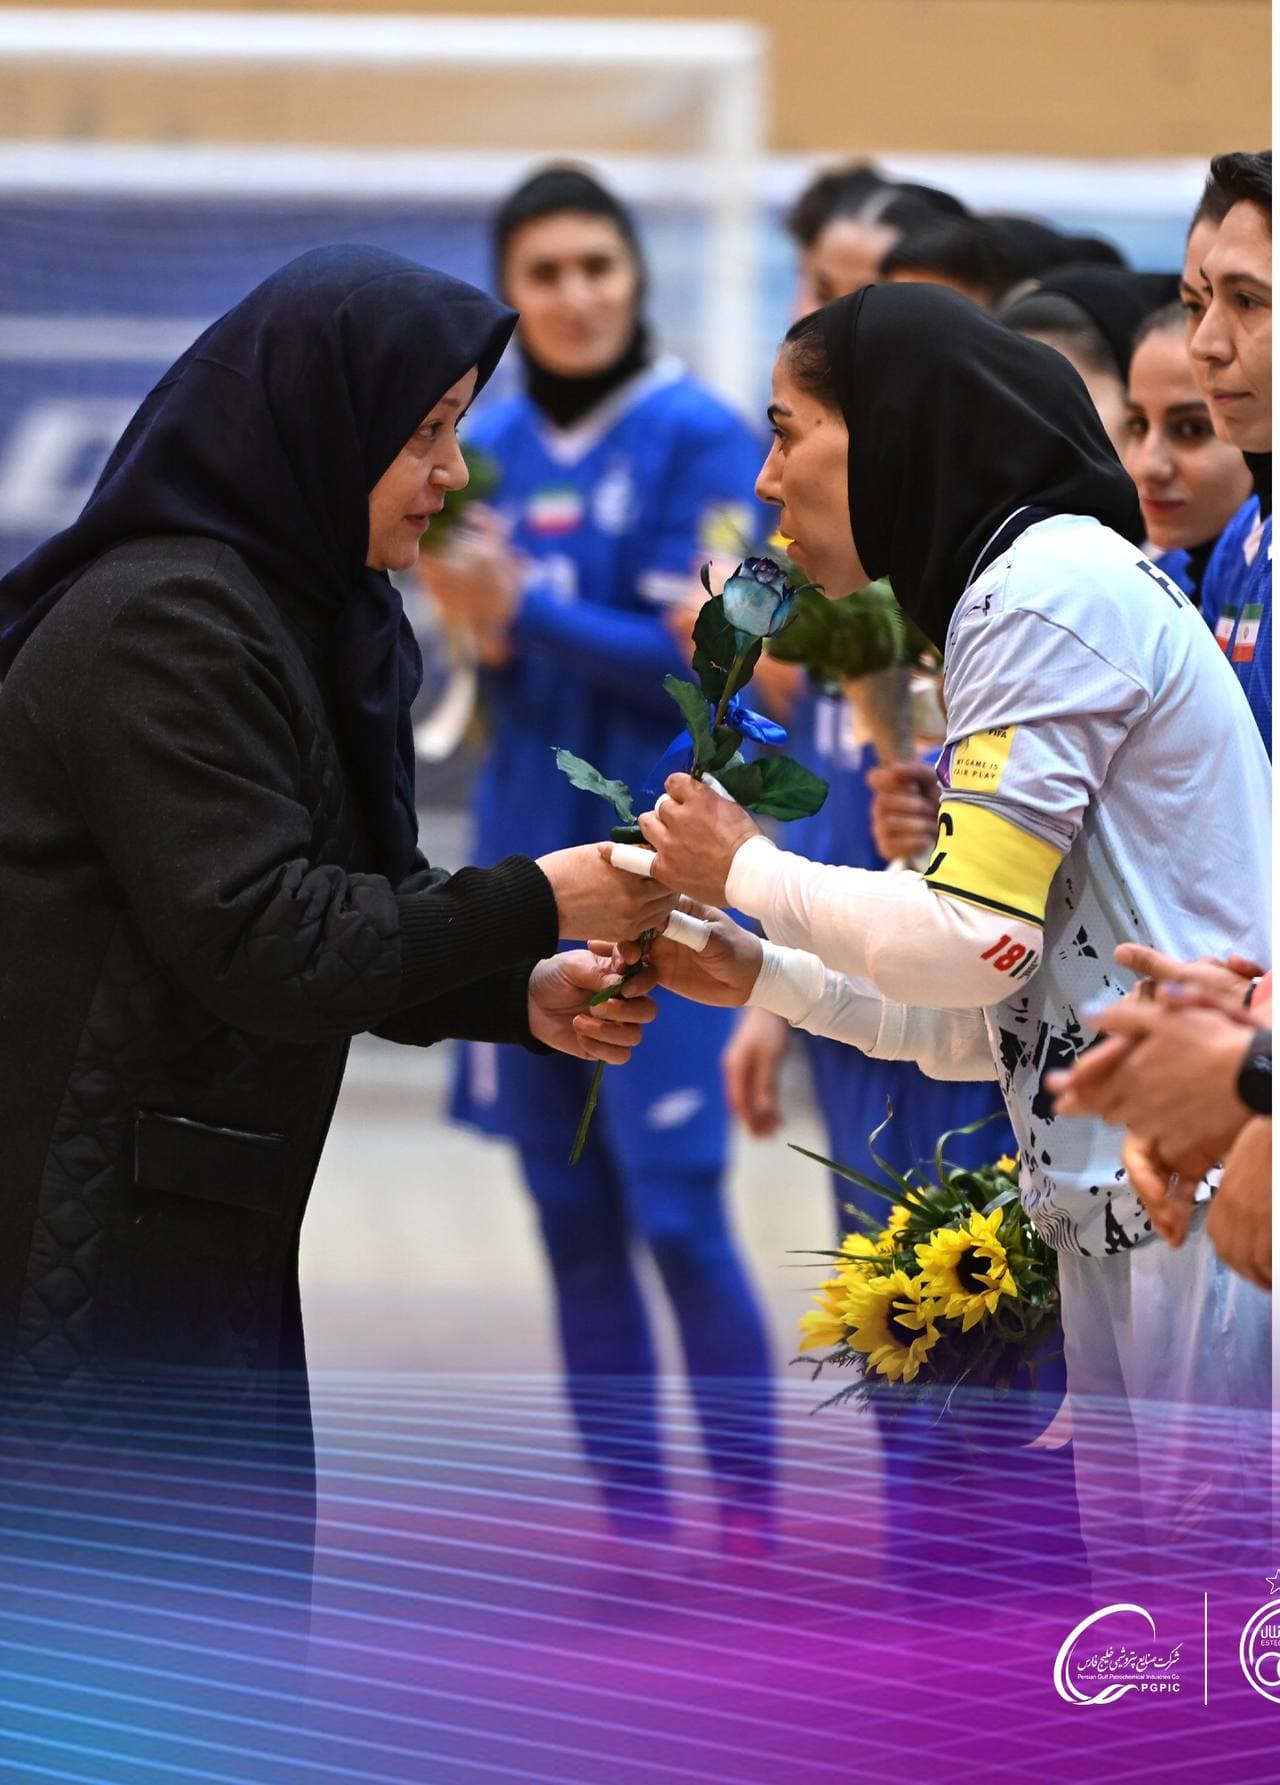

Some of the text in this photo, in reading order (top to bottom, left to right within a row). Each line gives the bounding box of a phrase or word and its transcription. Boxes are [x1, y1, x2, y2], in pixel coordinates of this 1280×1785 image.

[966, 760, 986, 768] GAME
[972, 770, 995, 779] PLAY
[980, 934, 1026, 971] 18
